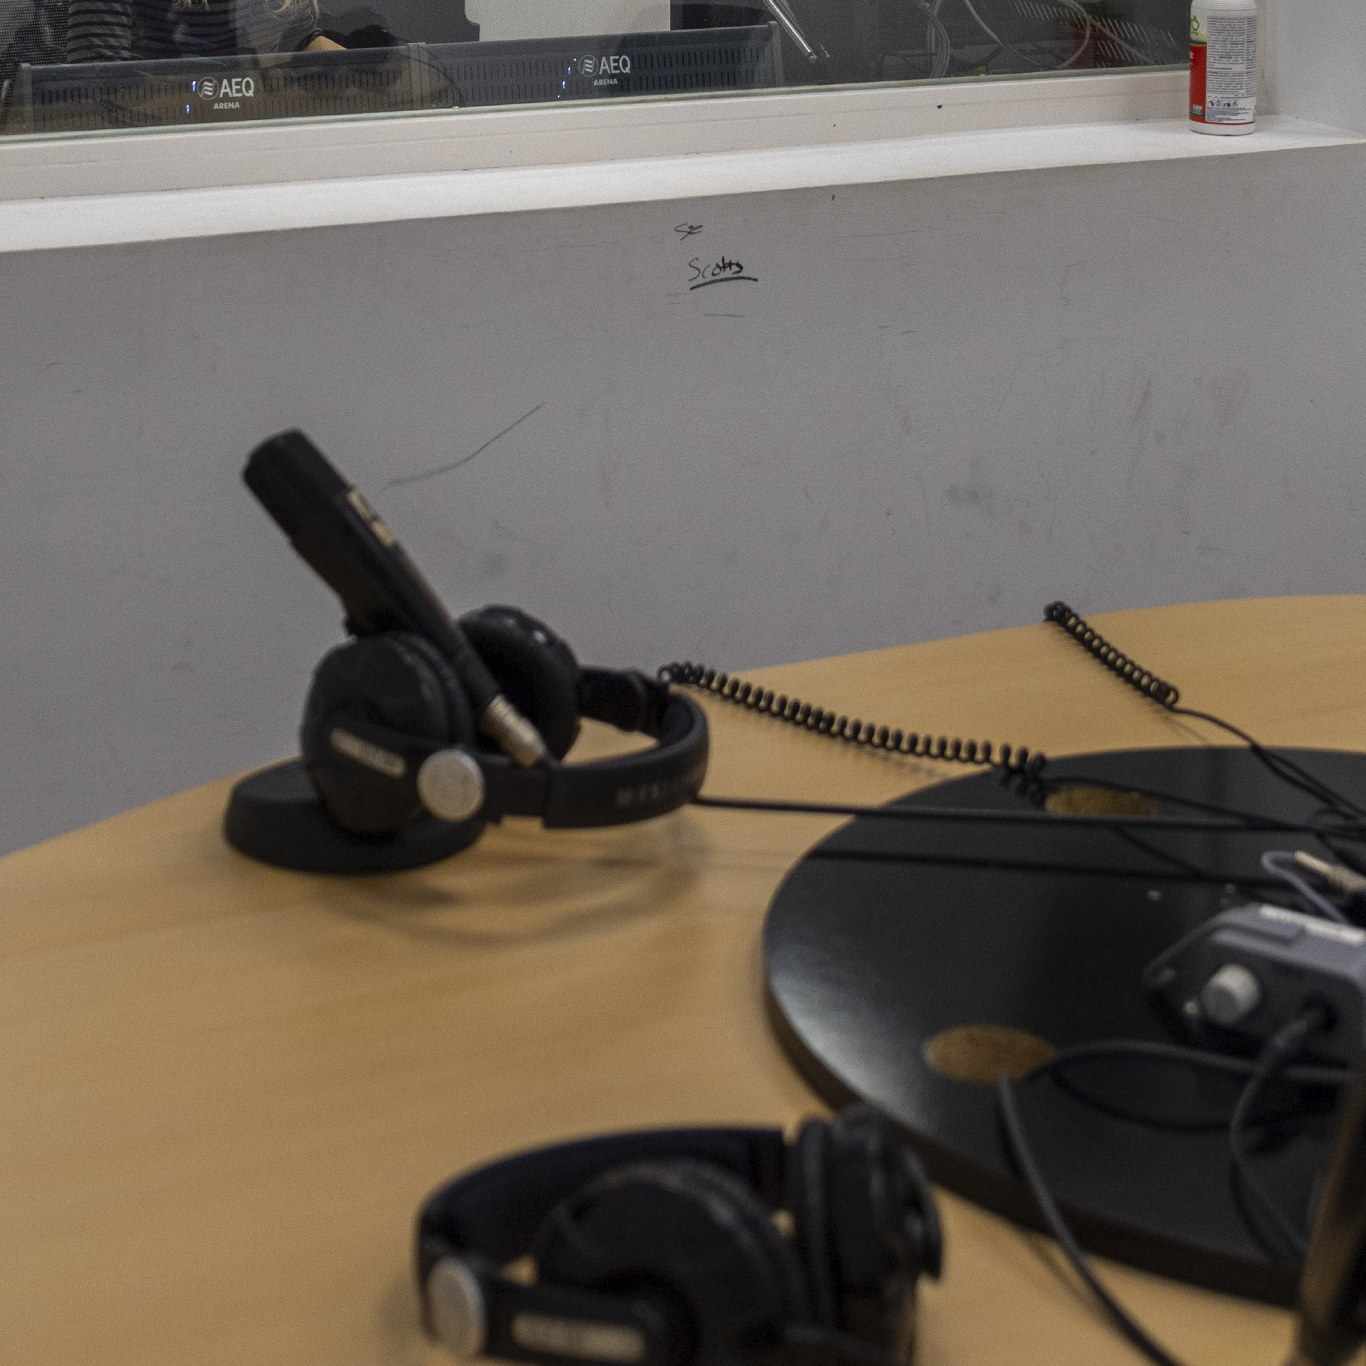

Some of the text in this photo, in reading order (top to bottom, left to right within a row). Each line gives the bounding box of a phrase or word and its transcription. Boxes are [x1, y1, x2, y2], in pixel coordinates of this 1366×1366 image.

[599, 55, 631, 75] AEQ
[220, 77, 255, 98] AEQ
[593, 78, 618, 86] ARENA
[214, 101, 240, 110] ARENA
